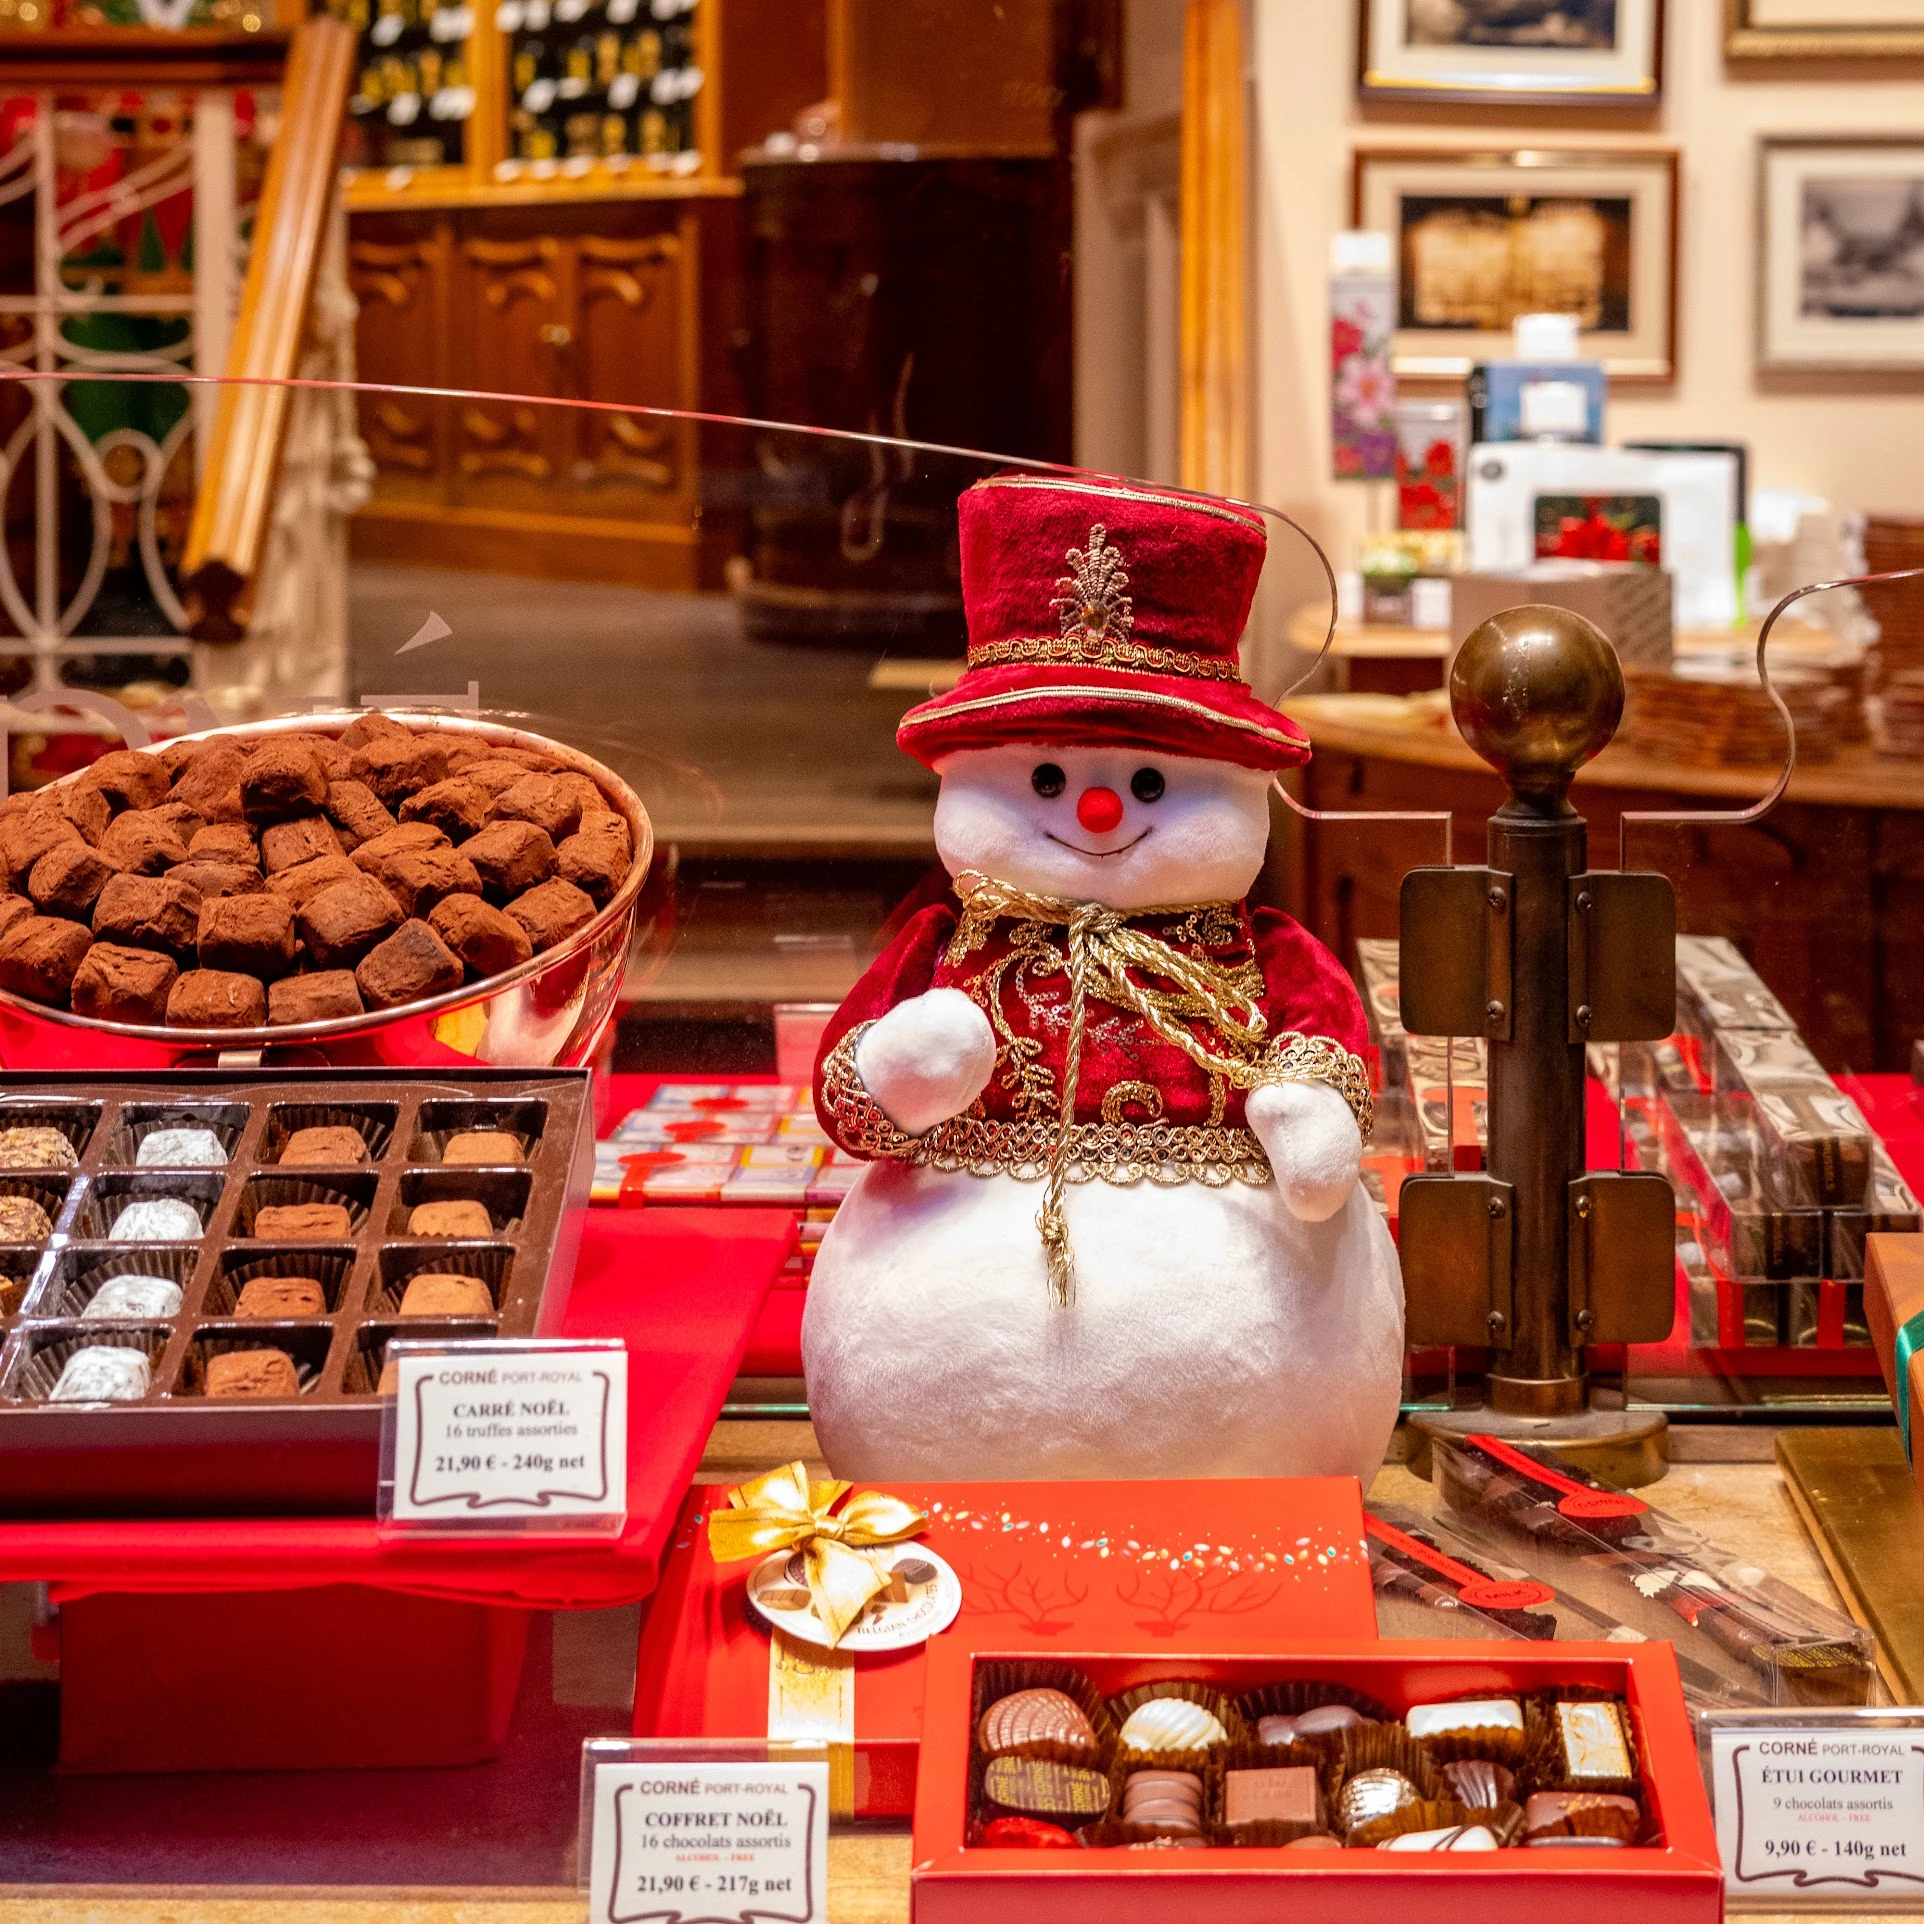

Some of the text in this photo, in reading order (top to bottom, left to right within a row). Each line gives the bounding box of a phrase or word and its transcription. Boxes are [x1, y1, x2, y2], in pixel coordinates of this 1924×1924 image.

[438, 1367, 583, 1384] CORNÉ PORT-ROYAL
[453, 1400, 570, 1418] CARRÉ NOËL
[446, 1422, 578, 1438] 16 truffes assorties
[436, 1456, 481, 1473] 21,90
[486, 1456, 497, 1470] €
[513, 1454, 554, 1472] 240g
[558, 1454, 585, 1468] net
[1759, 1738, 1905, 1756] CORNÉ PORT-ROYAL
[1761, 1766, 1903, 1784] ÉTUI GOURMET
[640, 1777, 788, 1794] CORNÉ PORT-ROYAL
[1773, 1796, 1894, 1810] 9 chocolats assortis
[645, 1808, 788, 1827] COFFRET NOËL
[1797, 1814, 1840, 1822] ALCOHOL
[1848, 1814, 1872, 1822] FREE
[641, 1834, 792, 1848] 16 chocolats assortis
[1765, 1840, 1800, 1858] 9,90
[1806, 1840, 1817, 1856] €
[1834, 1840, 1875, 1860] 140g
[1880, 1840, 1907, 1856] net
[637, 1875, 684, 1894] 21,90
[689, 1876, 700, 1892] €
[717, 1875, 759, 1895] 217g
[764, 1876, 792, 1891] net
